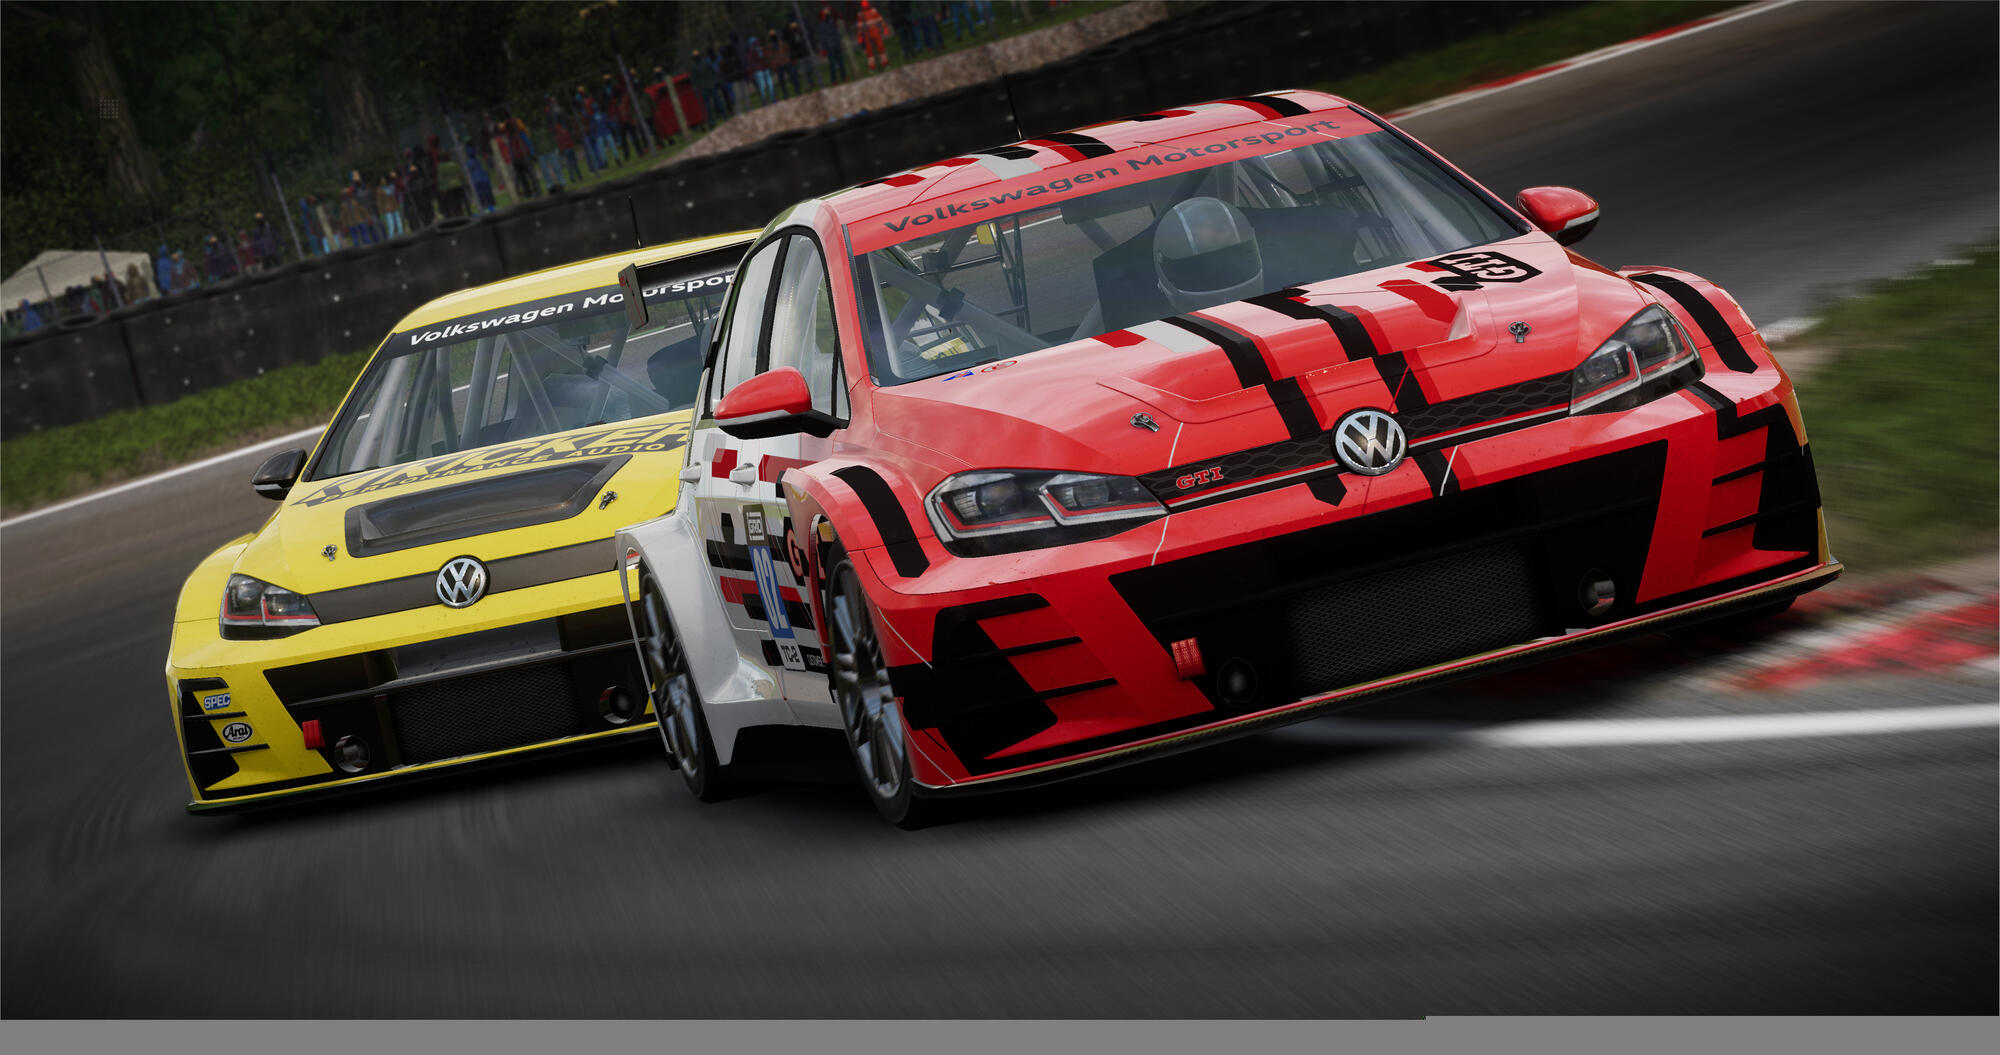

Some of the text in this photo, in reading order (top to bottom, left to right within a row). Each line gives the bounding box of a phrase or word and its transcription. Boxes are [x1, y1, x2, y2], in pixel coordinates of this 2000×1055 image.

[884, 117, 1341, 233] Volkswagen Motorsport
[410, 274, 735, 346] Volkswagen Moorspor
[321, 443, 665, 503] PERFORMANCE AUDIO
[1175, 466, 1225, 490] GTI
[753, 547, 790, 630] 02
[204, 693, 230, 709] SPEC
[225, 725, 249, 738] Arai
